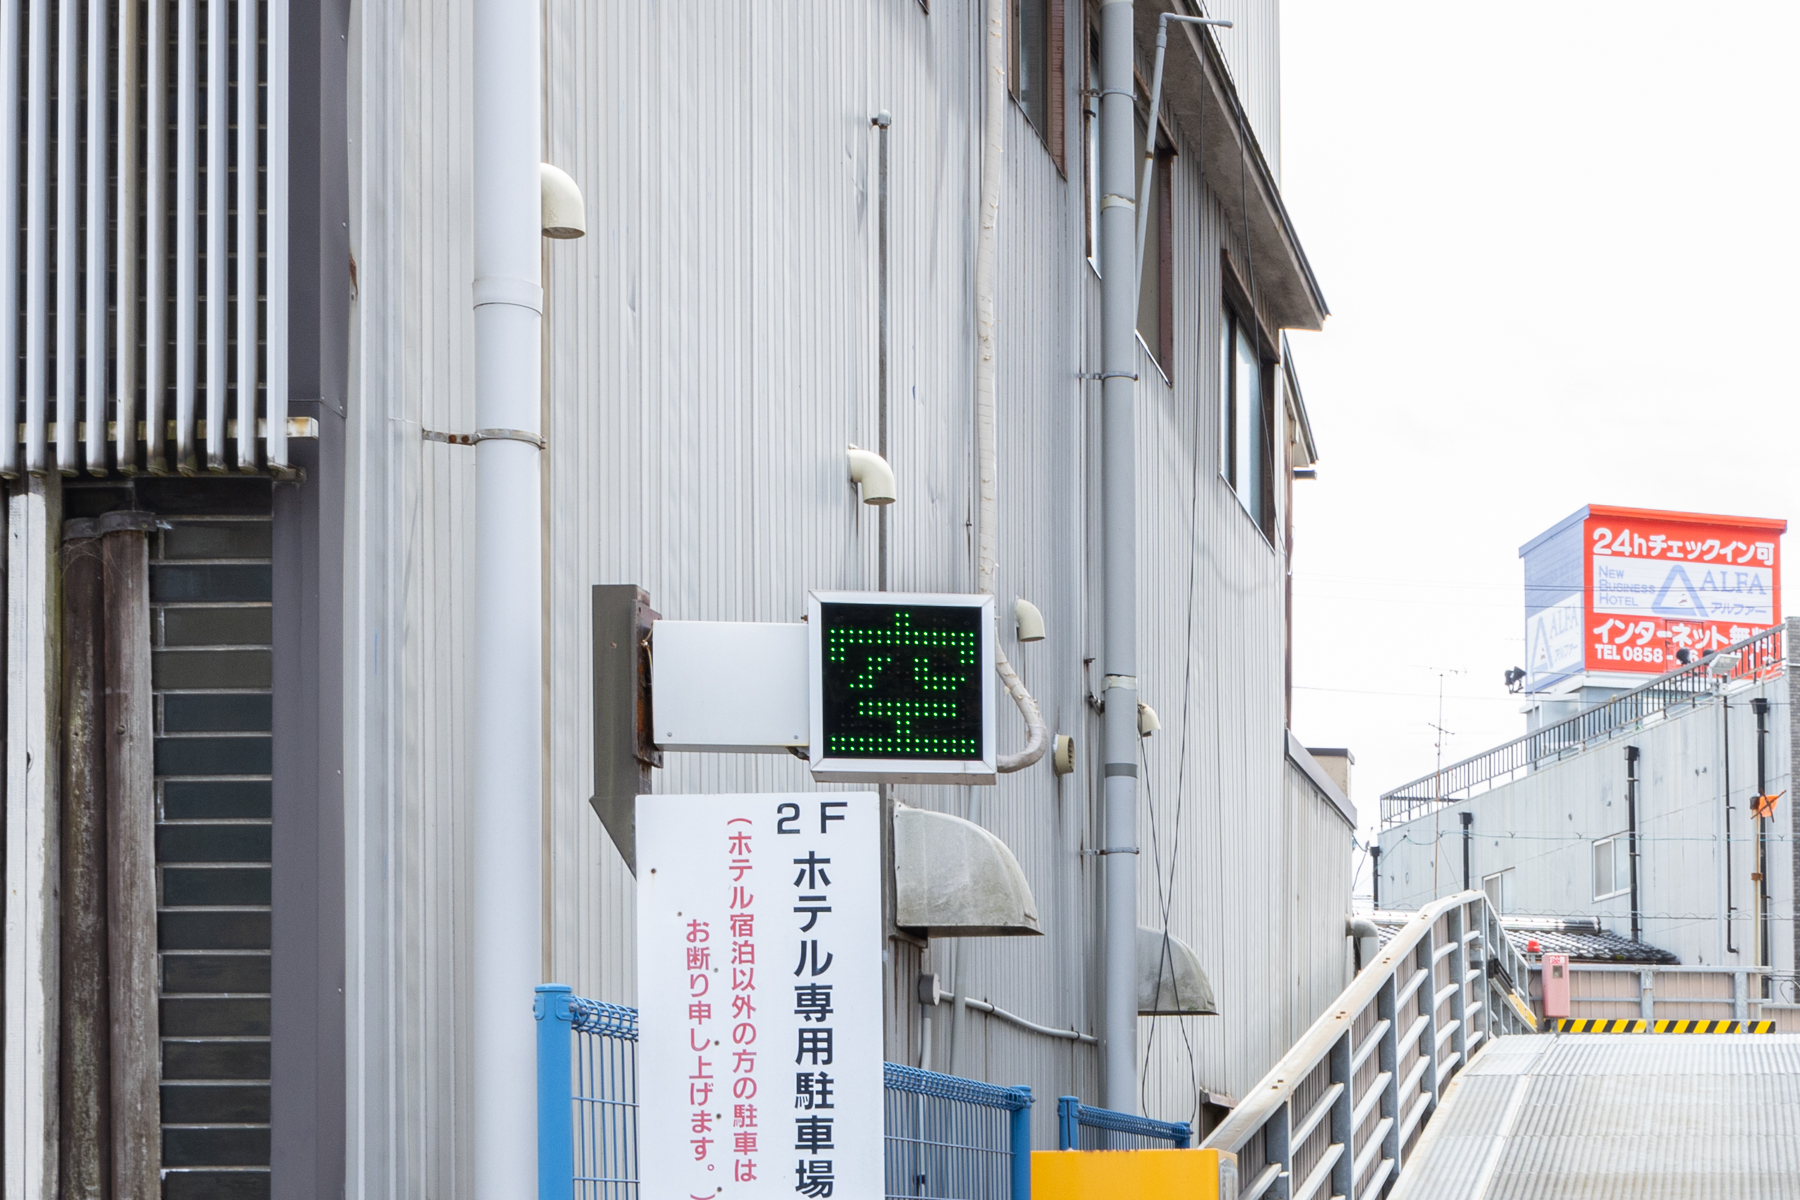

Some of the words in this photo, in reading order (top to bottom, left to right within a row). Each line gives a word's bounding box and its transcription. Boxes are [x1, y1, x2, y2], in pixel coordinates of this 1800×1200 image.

[1593, 527, 1775, 566] 24hチェックイン可
[1599, 565, 1624, 579] NEW
[1700, 570, 1767, 595] ALFA
[1599, 579, 1656, 594] BUSINESS
[1599, 593, 1639, 606] HOTEL
[1595, 644, 1624, 660] TEL
[830, 612, 976, 753] 空
[776, 802, 848, 835] 2F
[793, 850, 835, 1199] ホテル専用駐車場
